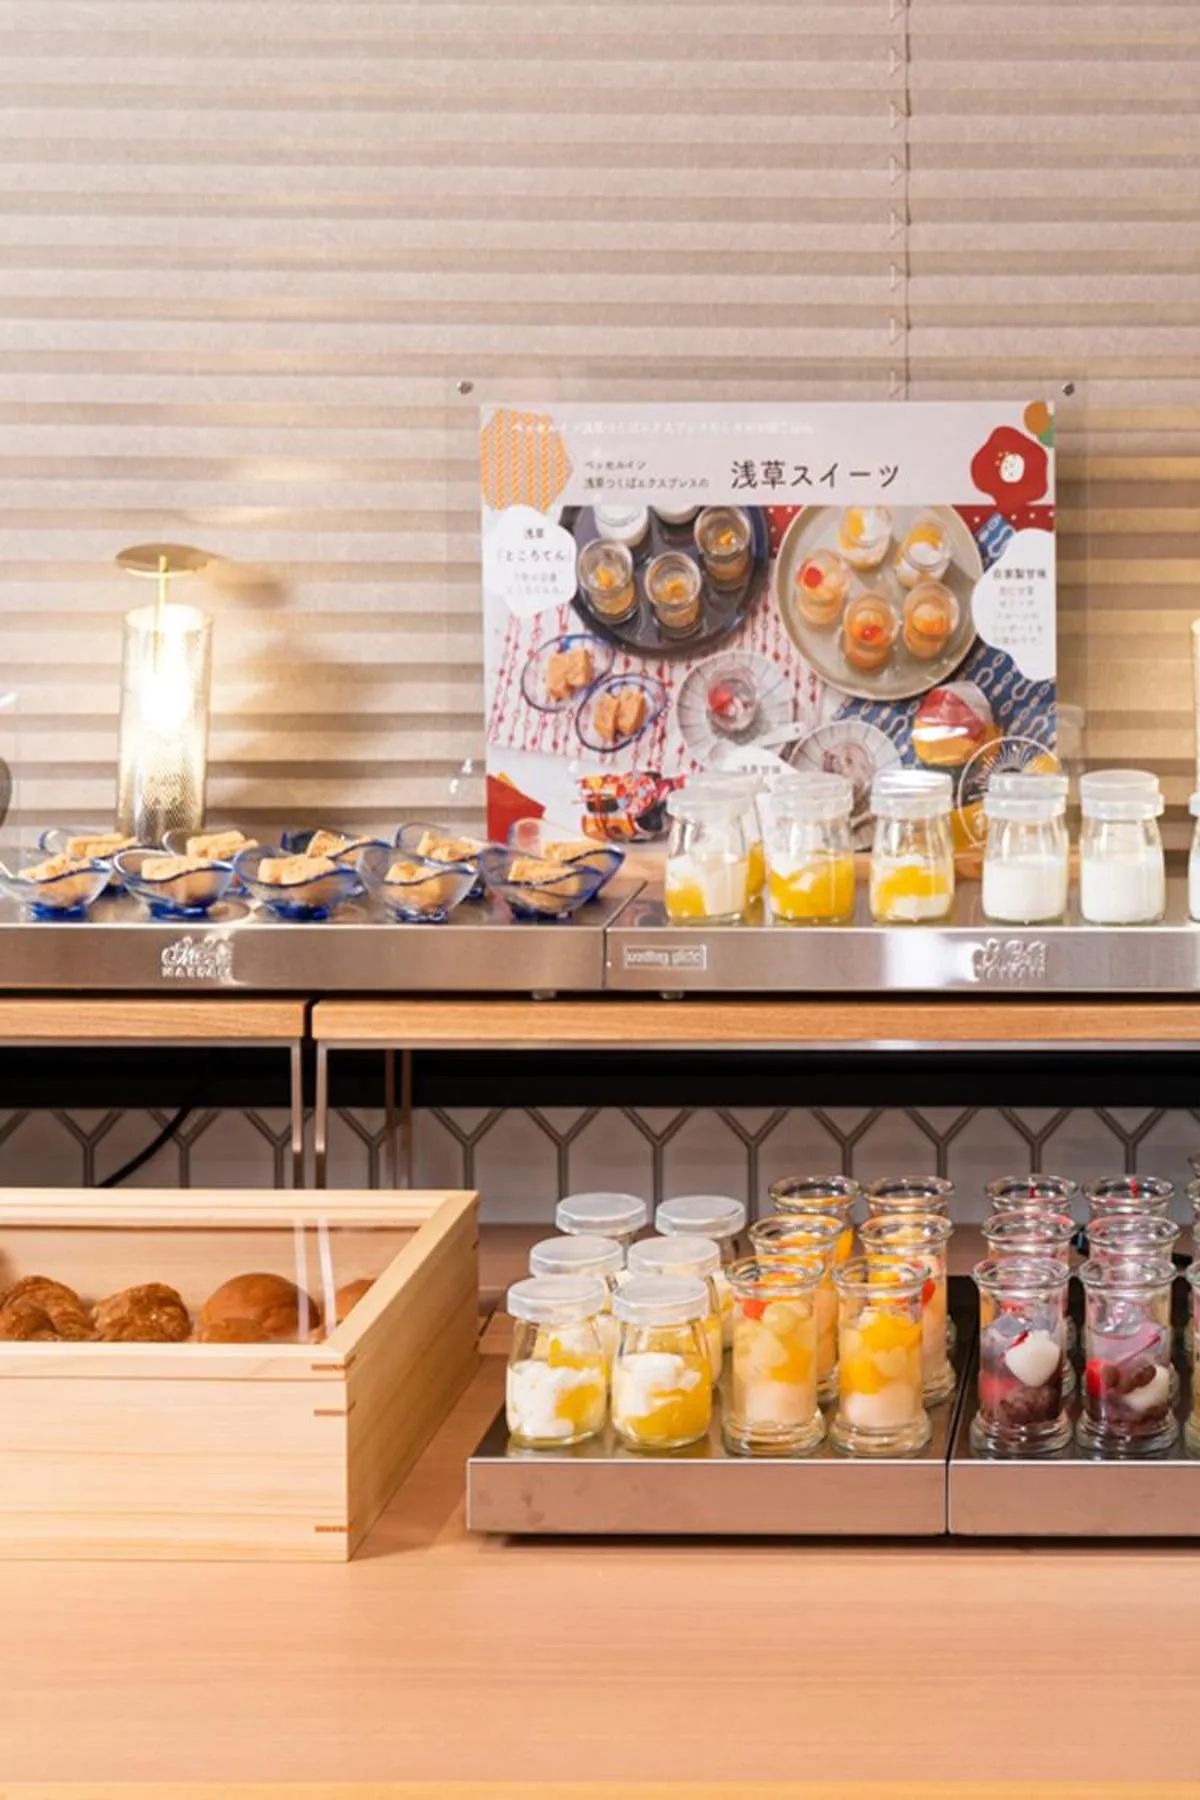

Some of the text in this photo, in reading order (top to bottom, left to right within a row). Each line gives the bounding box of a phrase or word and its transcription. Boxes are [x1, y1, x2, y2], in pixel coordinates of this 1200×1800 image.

[730, 459, 900, 490] 浅草スイーツ
